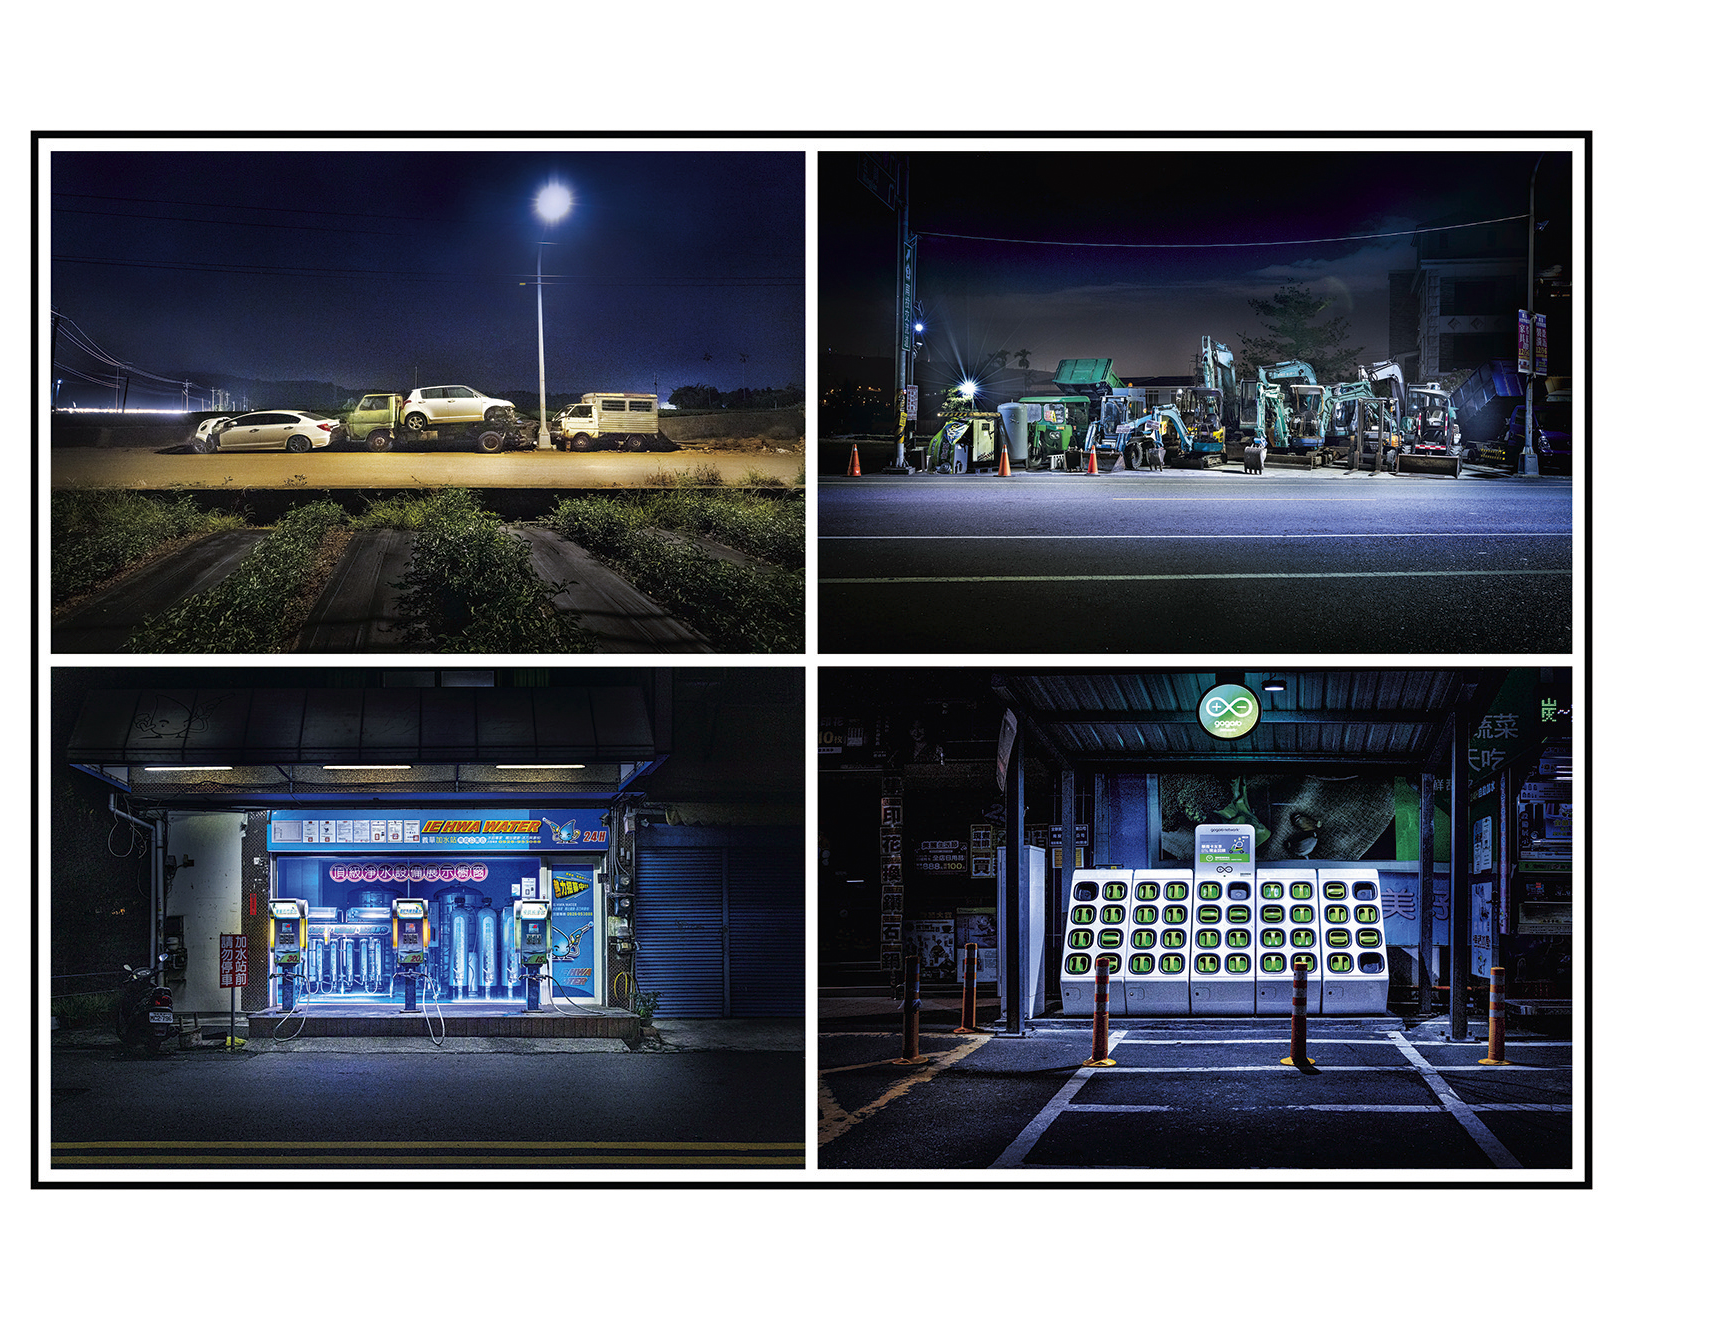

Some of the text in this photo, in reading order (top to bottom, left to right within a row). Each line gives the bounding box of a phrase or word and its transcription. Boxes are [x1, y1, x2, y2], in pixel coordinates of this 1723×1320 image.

[440, 820, 482, 833] HWA
[482, 820, 542, 833] WATER
[583, 831, 606, 842] 24H
[221, 936, 233, 986] 請勿停車
[235, 936, 247, 985] 加水站前
